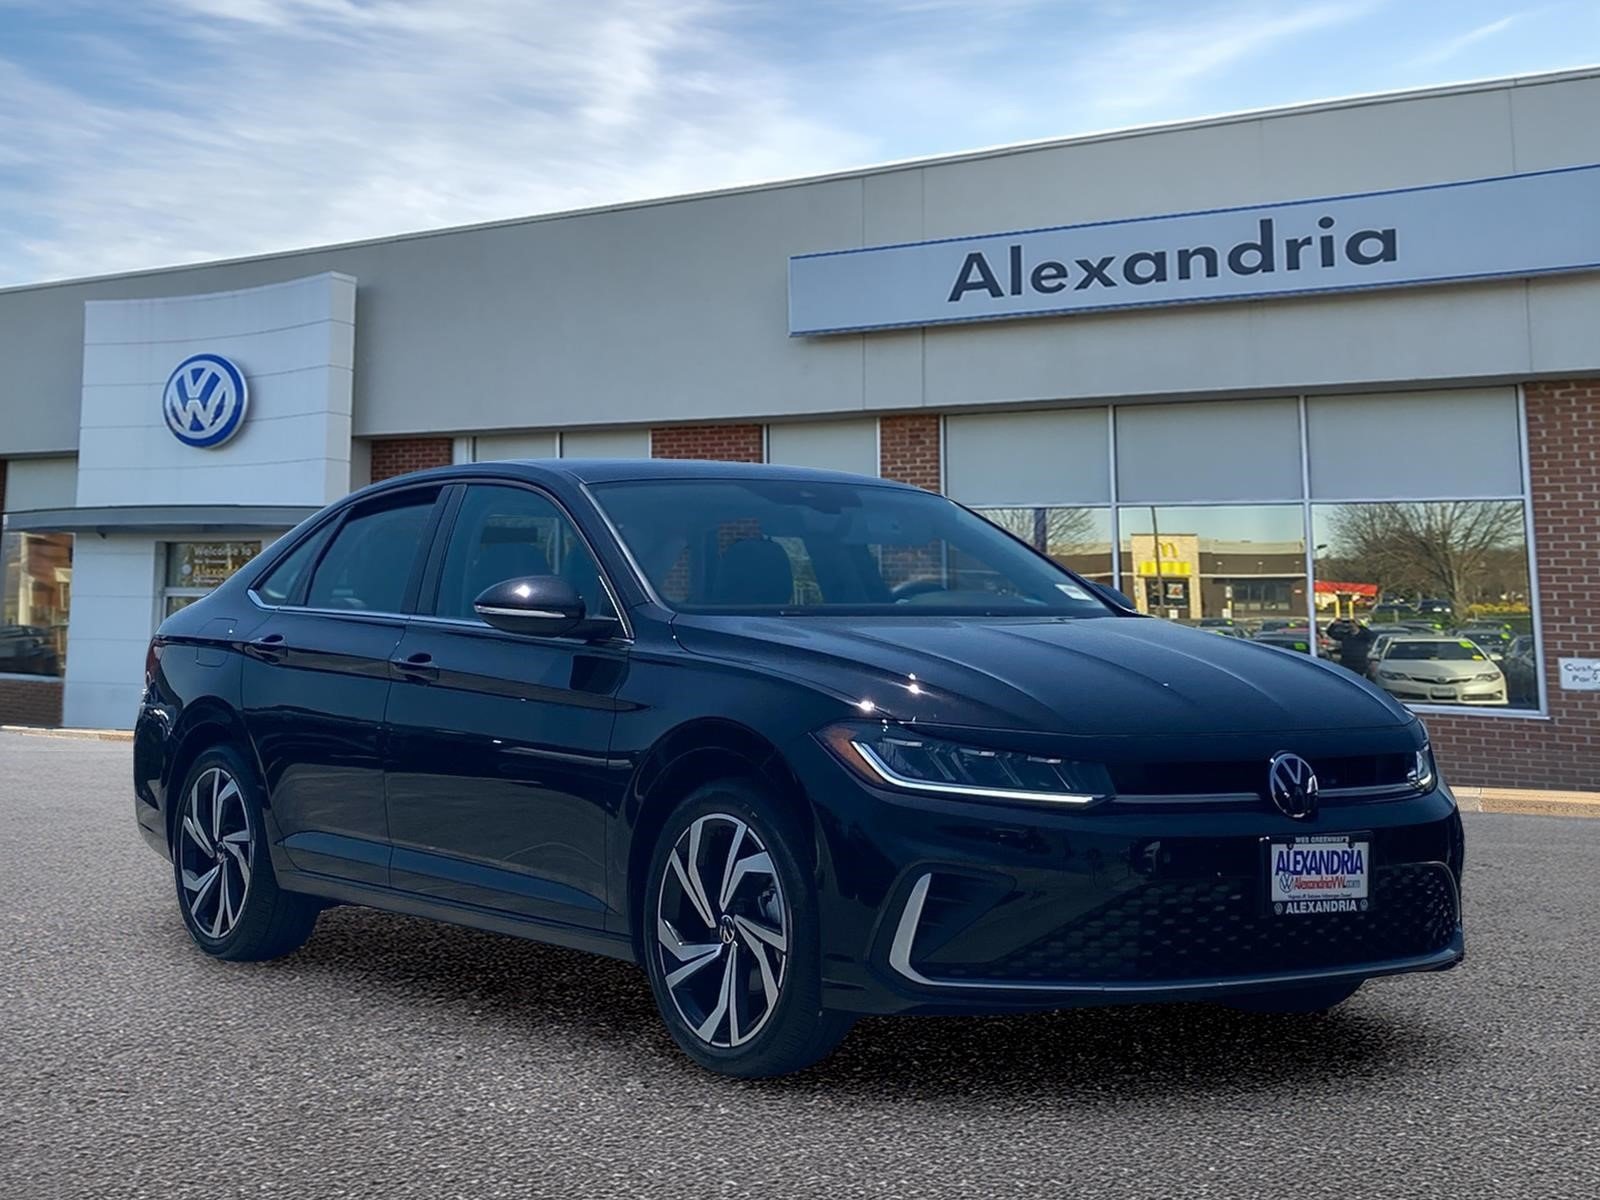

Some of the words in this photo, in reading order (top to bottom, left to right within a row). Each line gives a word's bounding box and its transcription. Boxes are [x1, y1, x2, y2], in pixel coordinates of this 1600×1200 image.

[947, 216, 1398, 302] Alexandria
[1275, 849, 1364, 876] ALEXANDRIA
[1286, 900, 1358, 914] ALEXANDRIA
